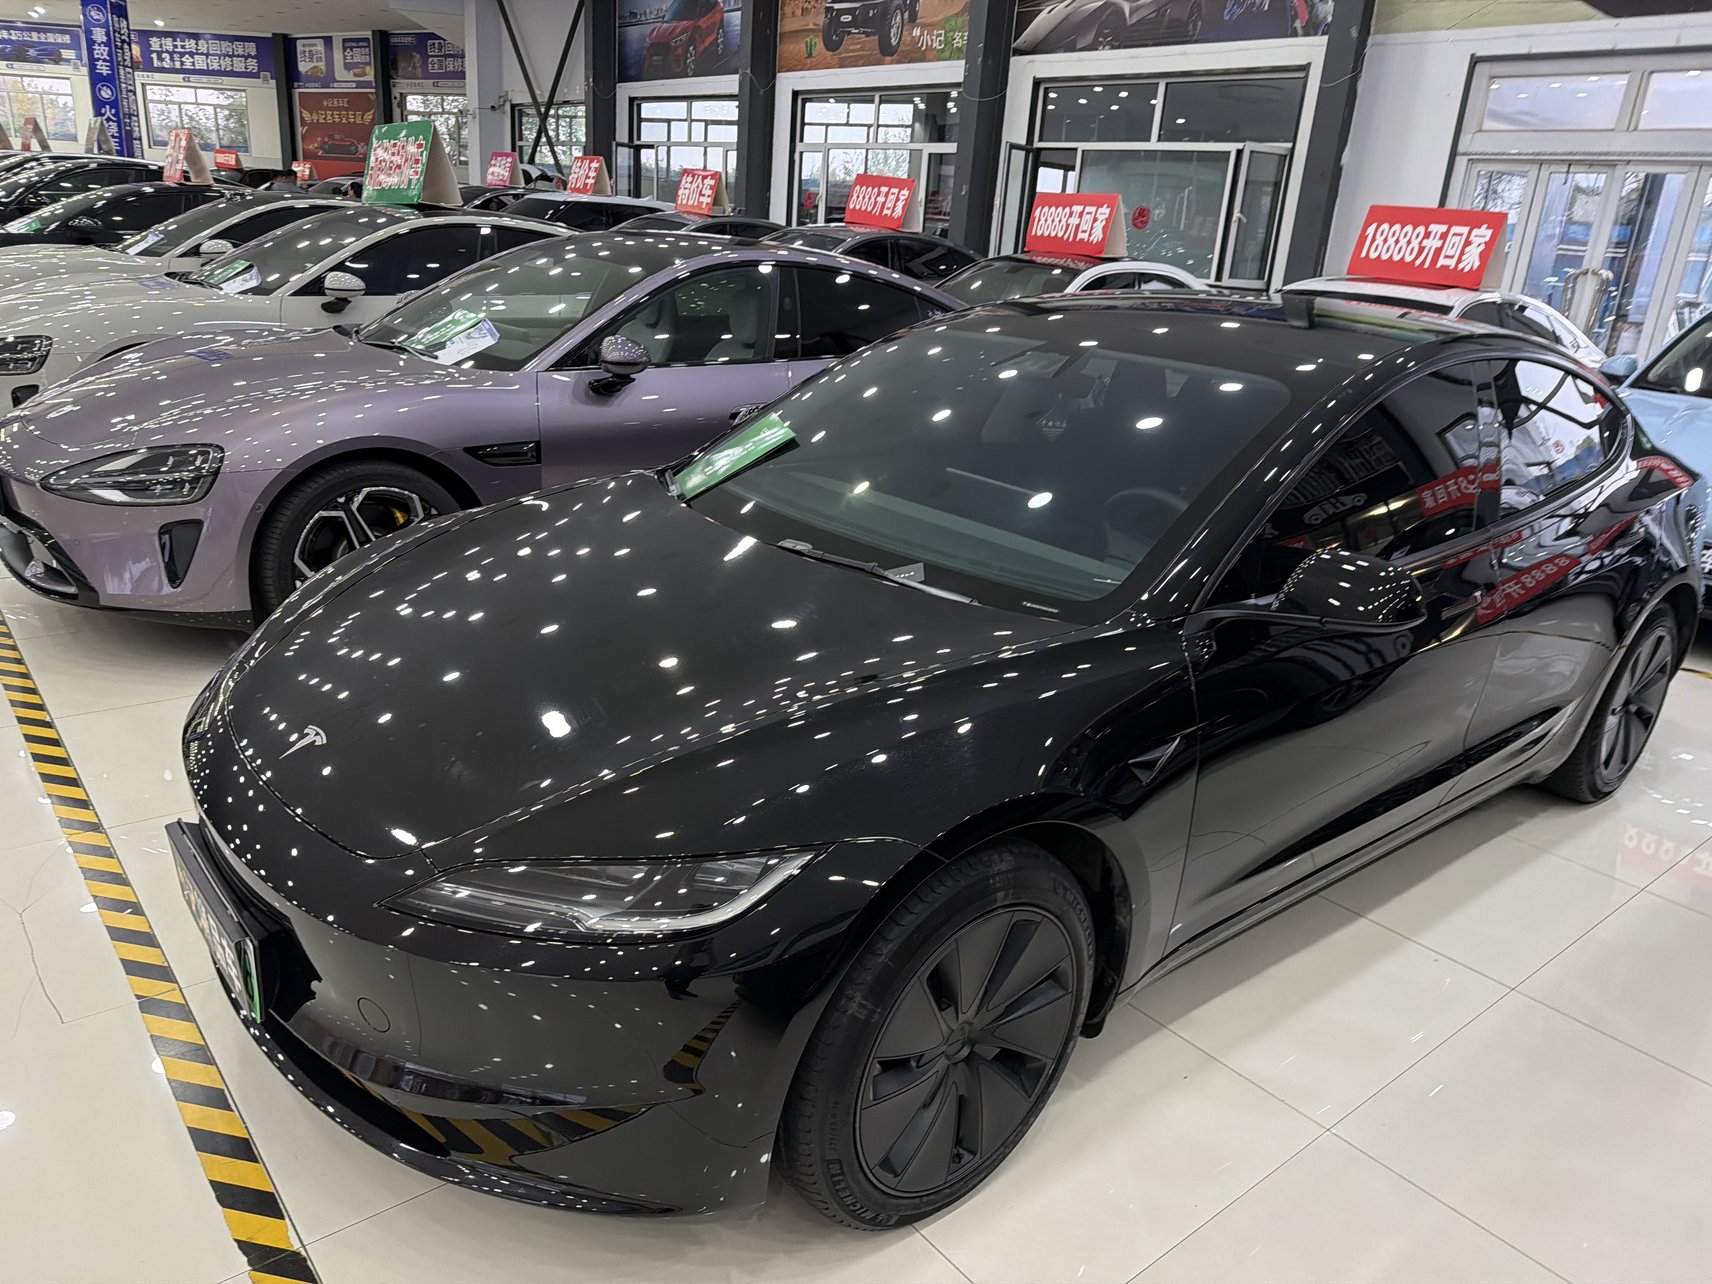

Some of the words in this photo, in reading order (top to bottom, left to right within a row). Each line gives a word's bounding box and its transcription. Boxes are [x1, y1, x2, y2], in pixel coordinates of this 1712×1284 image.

[90, 27, 112, 76] 事故车
[148, 37, 257, 56] 查博士终身回购保障
[568, 159, 600, 189] 特价车
[677, 172, 716, 208] 特价车
[849, 185, 910, 219] 8888开回家
[1031, 203, 1111, 244] 18888开回家
[1360, 222, 1494, 273] 18888开回家
[829, 1163, 873, 1220] MICHELIN
